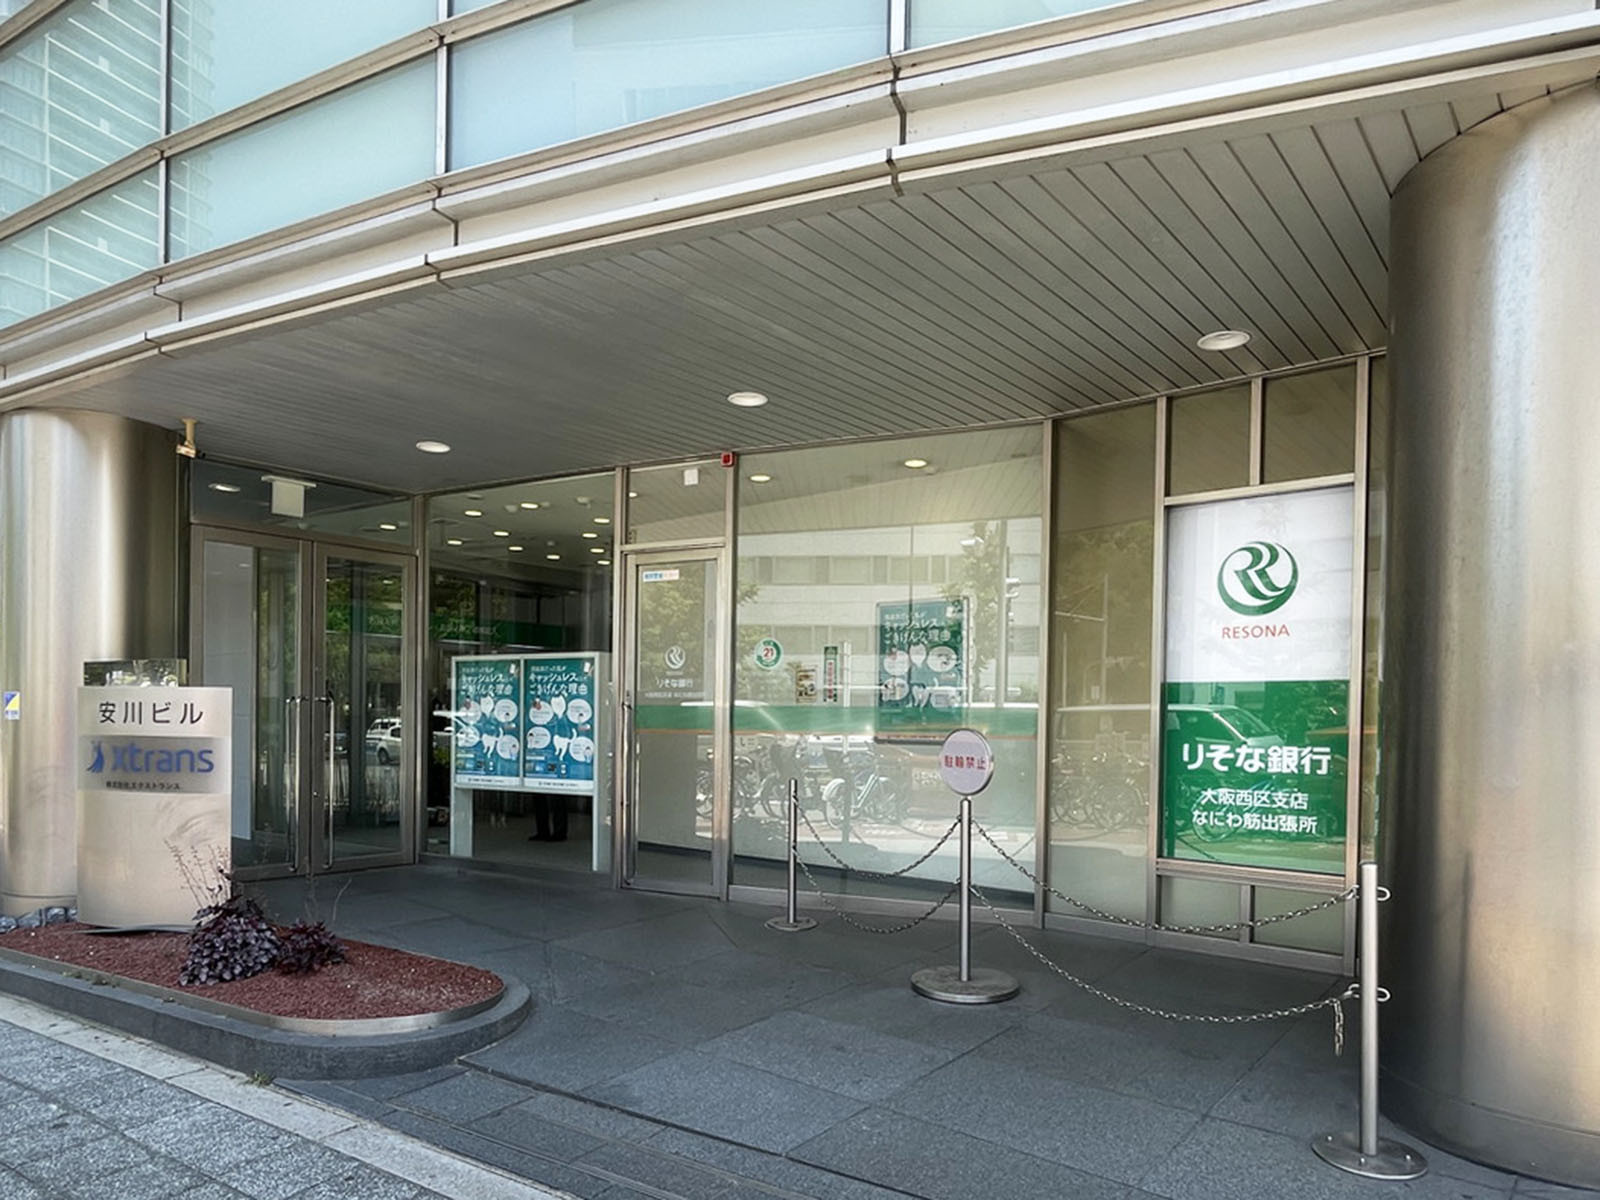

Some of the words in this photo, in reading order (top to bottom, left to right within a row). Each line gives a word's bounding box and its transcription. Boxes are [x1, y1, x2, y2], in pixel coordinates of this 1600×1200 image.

[1222, 624, 1290, 639] RESONA
[99, 701, 204, 725] 安川ビル
[112, 743, 214, 773] xtrans
[1182, 743, 1331, 775] りそな銀行
[1200, 788, 1309, 810] 大阪西区支店
[1192, 810, 1318, 834] なにわ筋出張所
